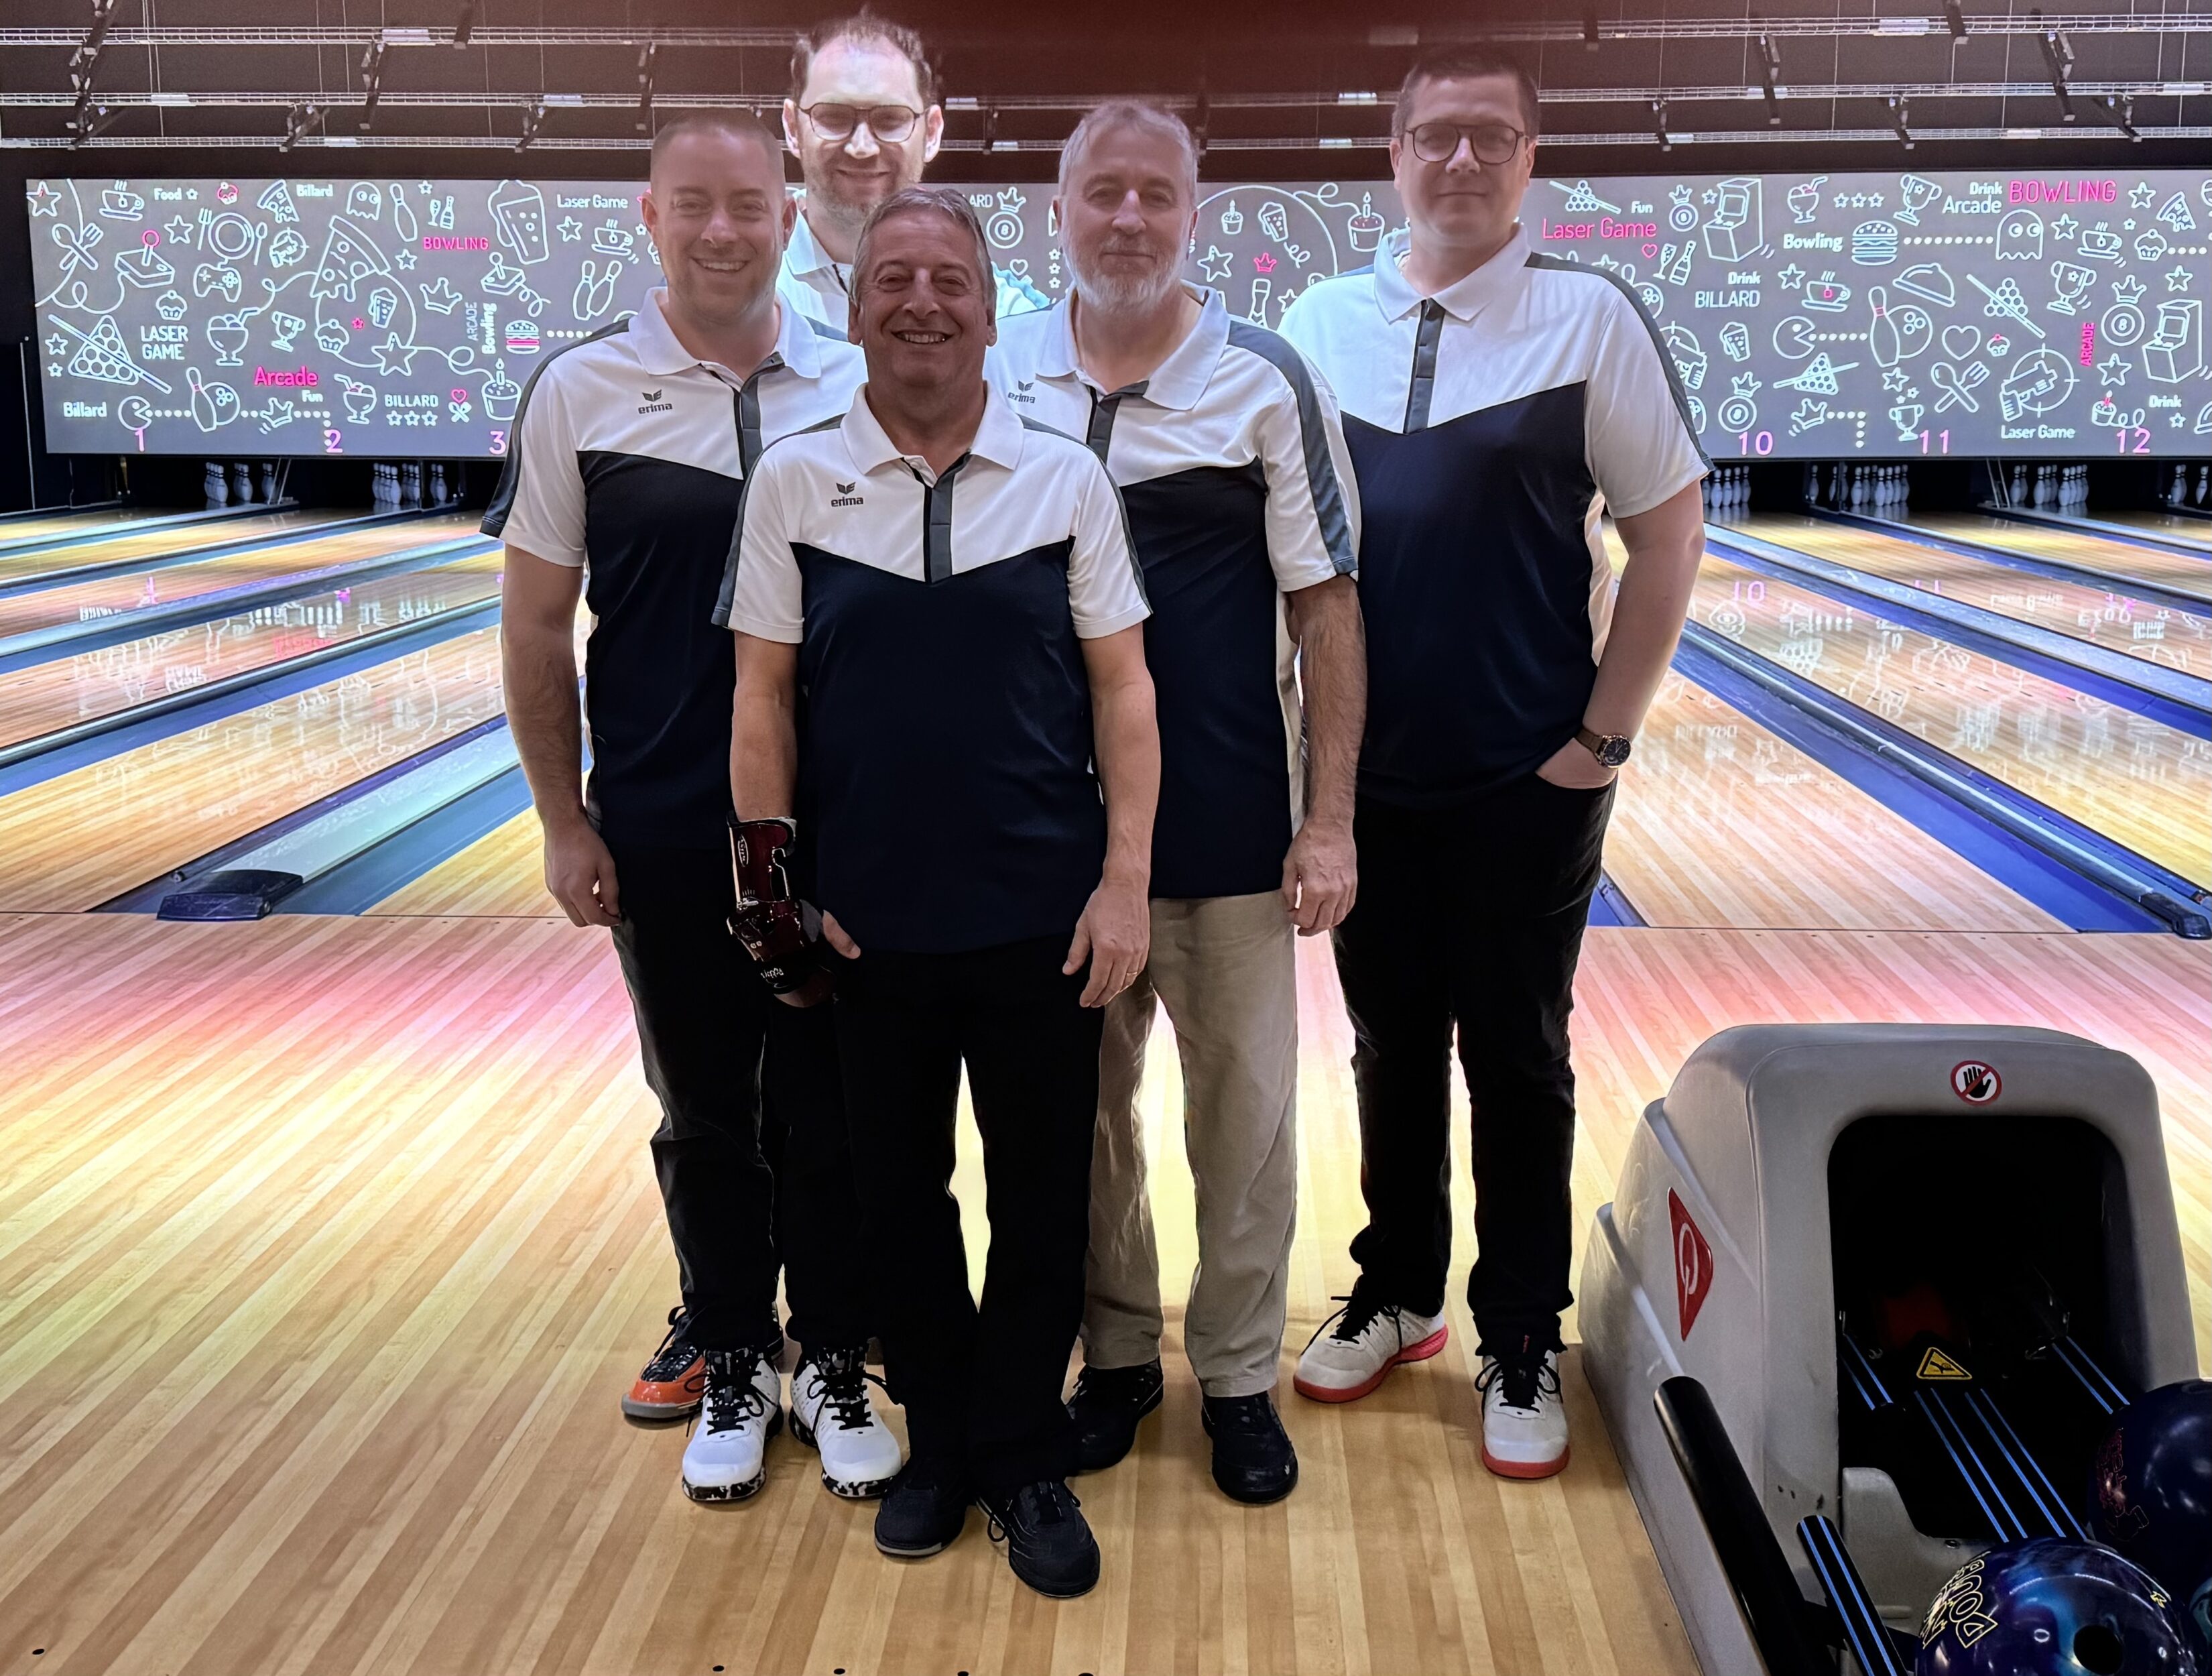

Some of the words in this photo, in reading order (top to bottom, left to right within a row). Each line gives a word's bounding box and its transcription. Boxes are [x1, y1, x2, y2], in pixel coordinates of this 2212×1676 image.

[153, 187, 182, 200] Food
[296, 184, 334, 197] Billard
[1970, 181, 2003, 195] Drink
[2010, 180, 2116, 203] BOWLING
[557, 194, 590, 208] Laser
[593, 194, 629, 209] Game
[969, 194, 993, 208] ARD
[1631, 200, 1654, 214] Fun
[1942, 196, 2002, 215] Arcade
[1543, 218, 1595, 239] Laser
[1601, 217, 1657, 238] Game
[423, 236, 489, 250] BOWLING
[1783, 233, 1843, 253] Bowling
[1727, 272, 1761, 285] Drink
[1695, 290, 1760, 308] BILLARD
[465, 302, 478, 341] ARCADE
[481, 303, 497, 355] Bowling
[140, 325, 189, 343] LASER
[141, 343, 185, 361] GAME
[2080, 322, 2095, 367] ARCADE
[254, 366, 318, 387] Arcade
[302, 390, 324, 403] Fun
[384, 394, 439, 408] BILLARD
[1007, 392, 1036, 404] erima
[2148, 394, 2182, 408] Drink
[63, 402, 107, 418] Billard
[637, 402, 673, 414] erima
[135, 429, 145, 452] 1
[2000, 424, 2036, 439] Laser
[2038, 424, 2076, 439] Game
[2116, 427, 2151, 453] 12
[326, 430, 343, 453] 2
[489, 430, 506, 455] 3
[1738, 430, 1773, 456] 10
[1919, 430, 1950, 455] 11
[831, 496, 864, 507] erima
